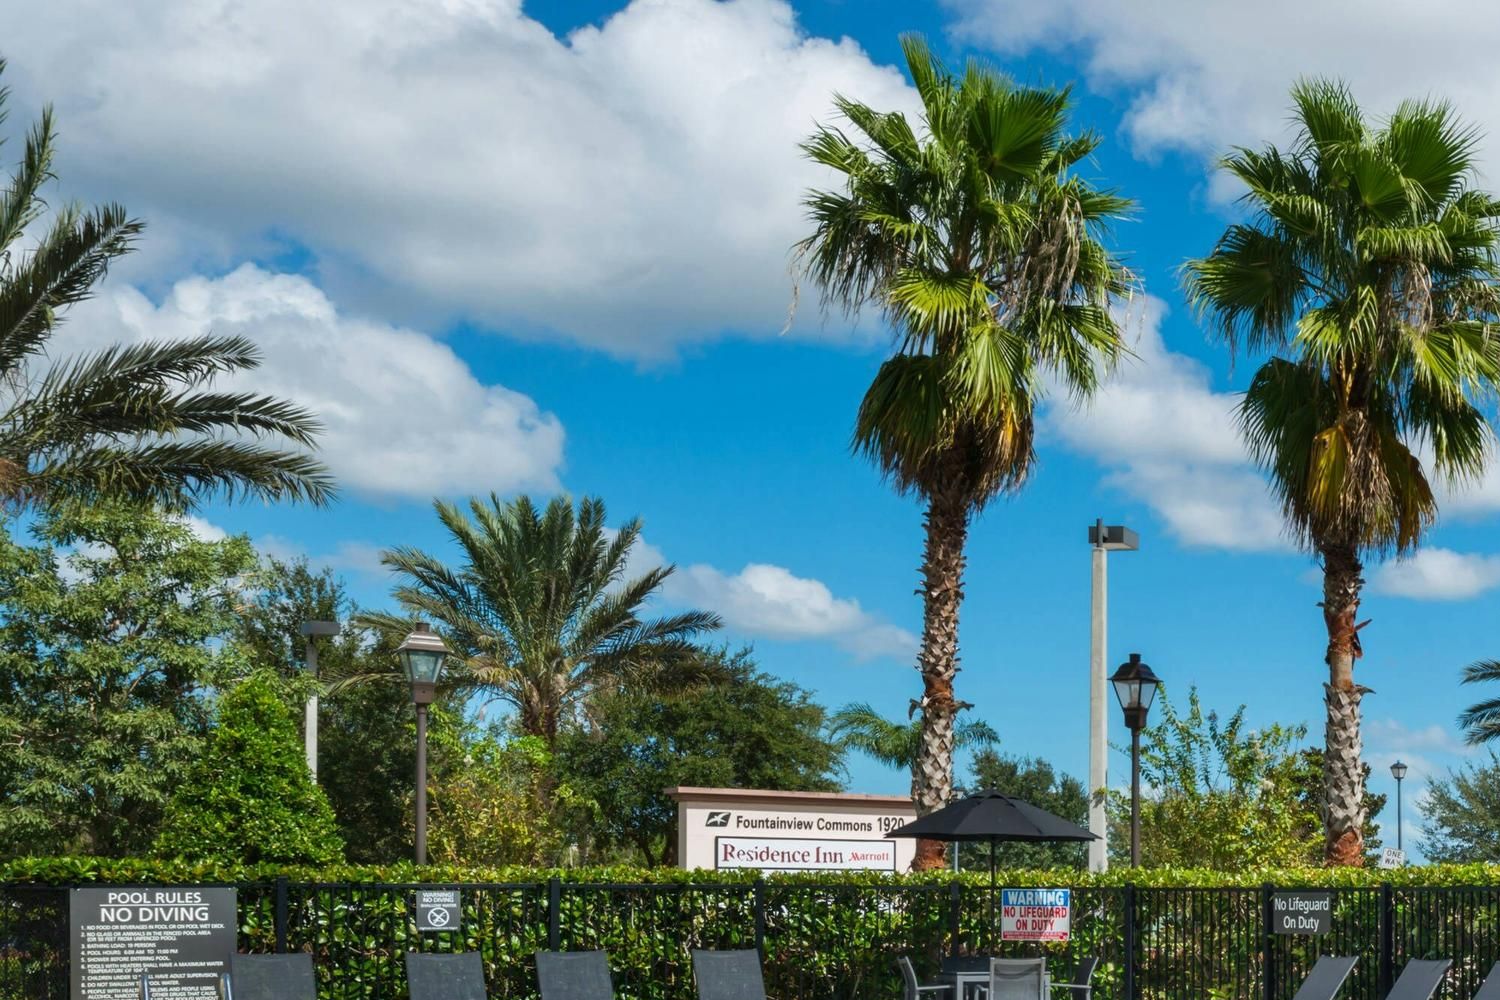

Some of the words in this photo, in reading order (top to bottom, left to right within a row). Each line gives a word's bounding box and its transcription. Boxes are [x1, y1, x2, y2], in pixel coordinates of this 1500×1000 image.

[736, 815, 813, 830] Fountainview
[817, 818, 872, 832] Commons
[877, 817, 905, 832] 1920
[722, 843, 810, 863] Residence
[815, 846, 843, 863] Inn
[848, 852, 889, 862] Marriott
[1386, 850, 1402, 859] ONE
[108, 892, 151, 904] POOL
[155, 892, 202, 904] RULES
[1008, 891, 1065, 906] WARNING
[1274, 897, 1287, 911] No
[1288, 896, 1329, 914] Lifeguard
[100, 907, 132, 922] NO
[138, 906, 209, 922] DIVING
[1003, 906, 1016, 918] NO
[1020, 906, 1067, 918] LIFEGUARD
[1015, 920, 1028, 931] ON
[1031, 920, 1055, 931] DUTY
[1283, 915, 1296, 929] On
[1298, 916, 1320, 932] Duty
